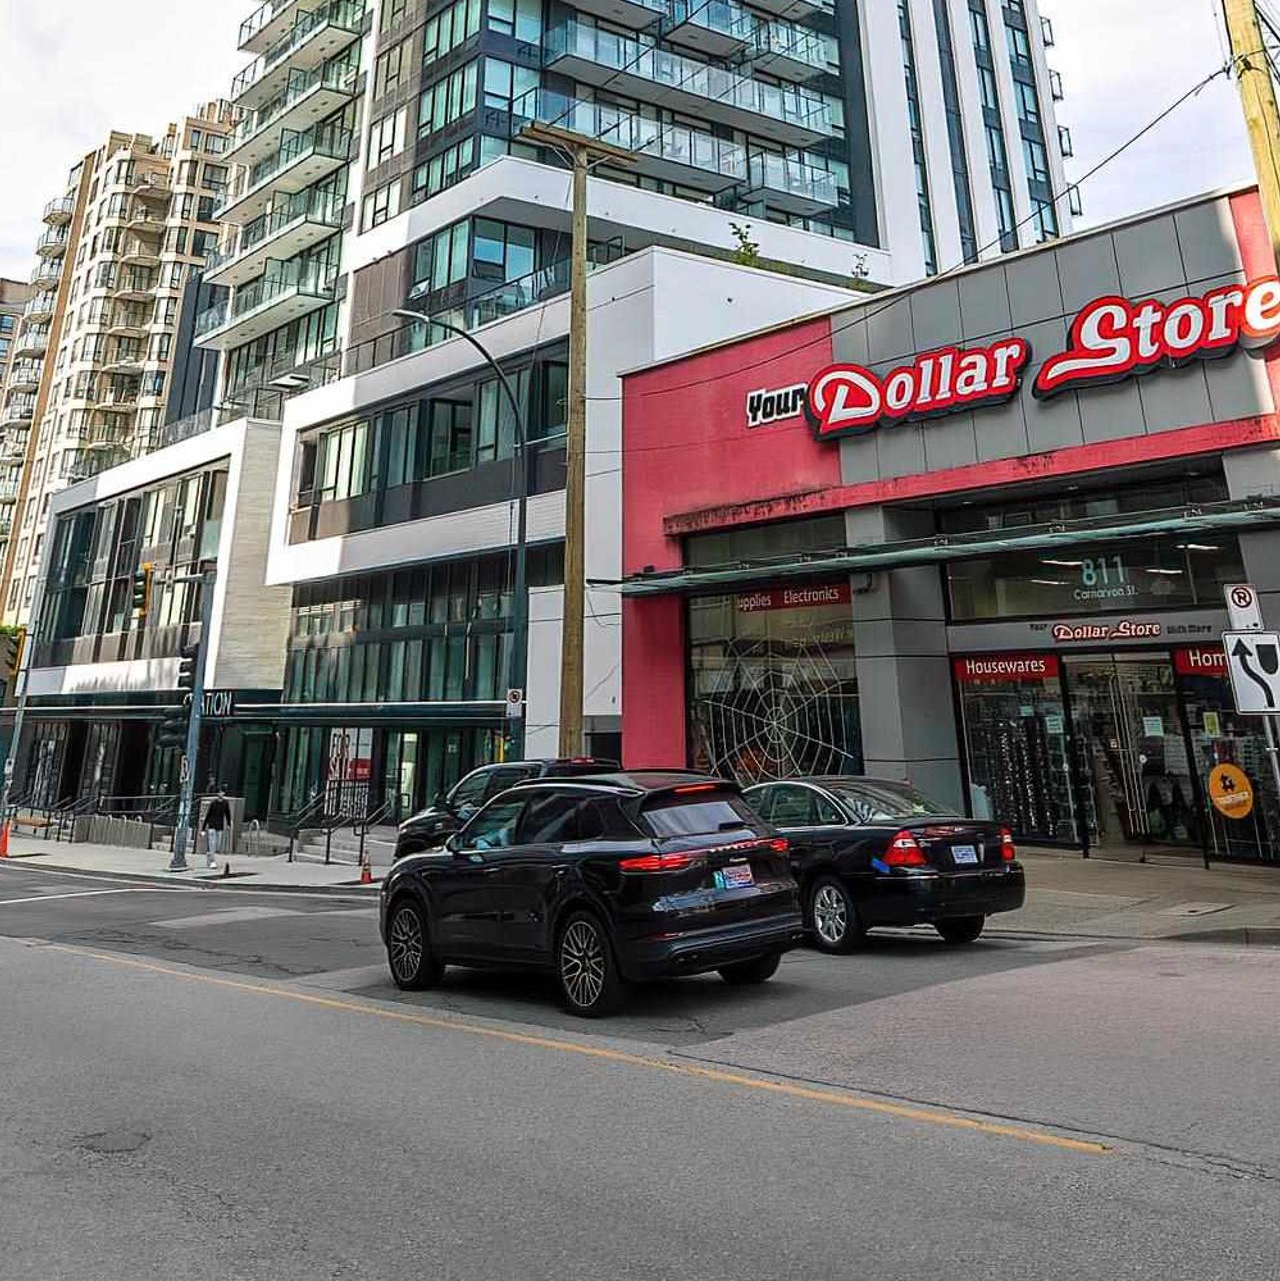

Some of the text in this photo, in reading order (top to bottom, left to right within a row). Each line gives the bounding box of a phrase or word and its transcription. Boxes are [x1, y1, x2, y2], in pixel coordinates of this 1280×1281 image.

[748, 387, 806, 421] Your
[813, 342, 1022, 424] Dollar
[1082, 556, 1125, 585] 811
[738, 586, 839, 611] upplies Electronics
[1054, 624, 1109, 640] Dollar
[1110, 621, 1161, 637] Store
[966, 648, 1227, 675] Housewares Hom
